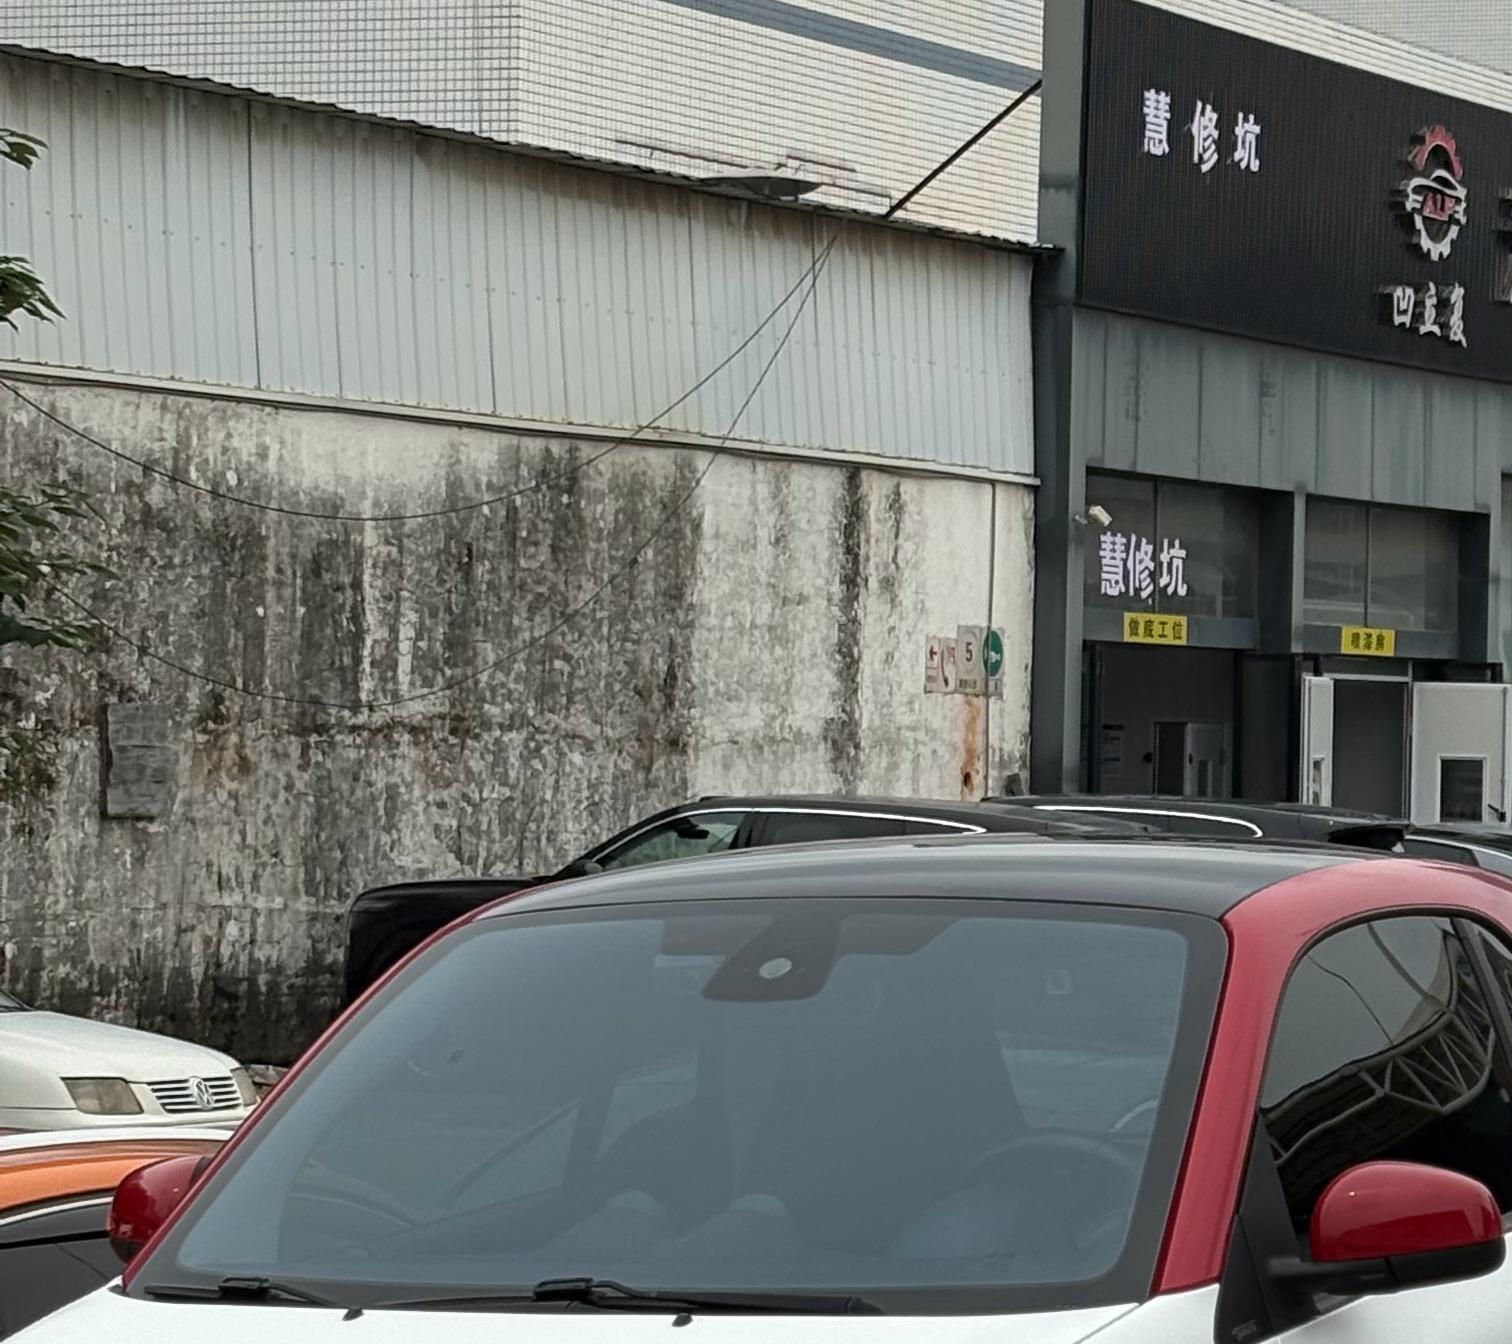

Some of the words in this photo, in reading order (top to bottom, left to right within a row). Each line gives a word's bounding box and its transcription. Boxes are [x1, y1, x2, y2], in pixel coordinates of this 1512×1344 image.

[1143, 89, 1261, 173] 慧修坑
[1392, 282, 1467, 348] 凹立复
[1099, 531, 1188, 603] 慧修坑
